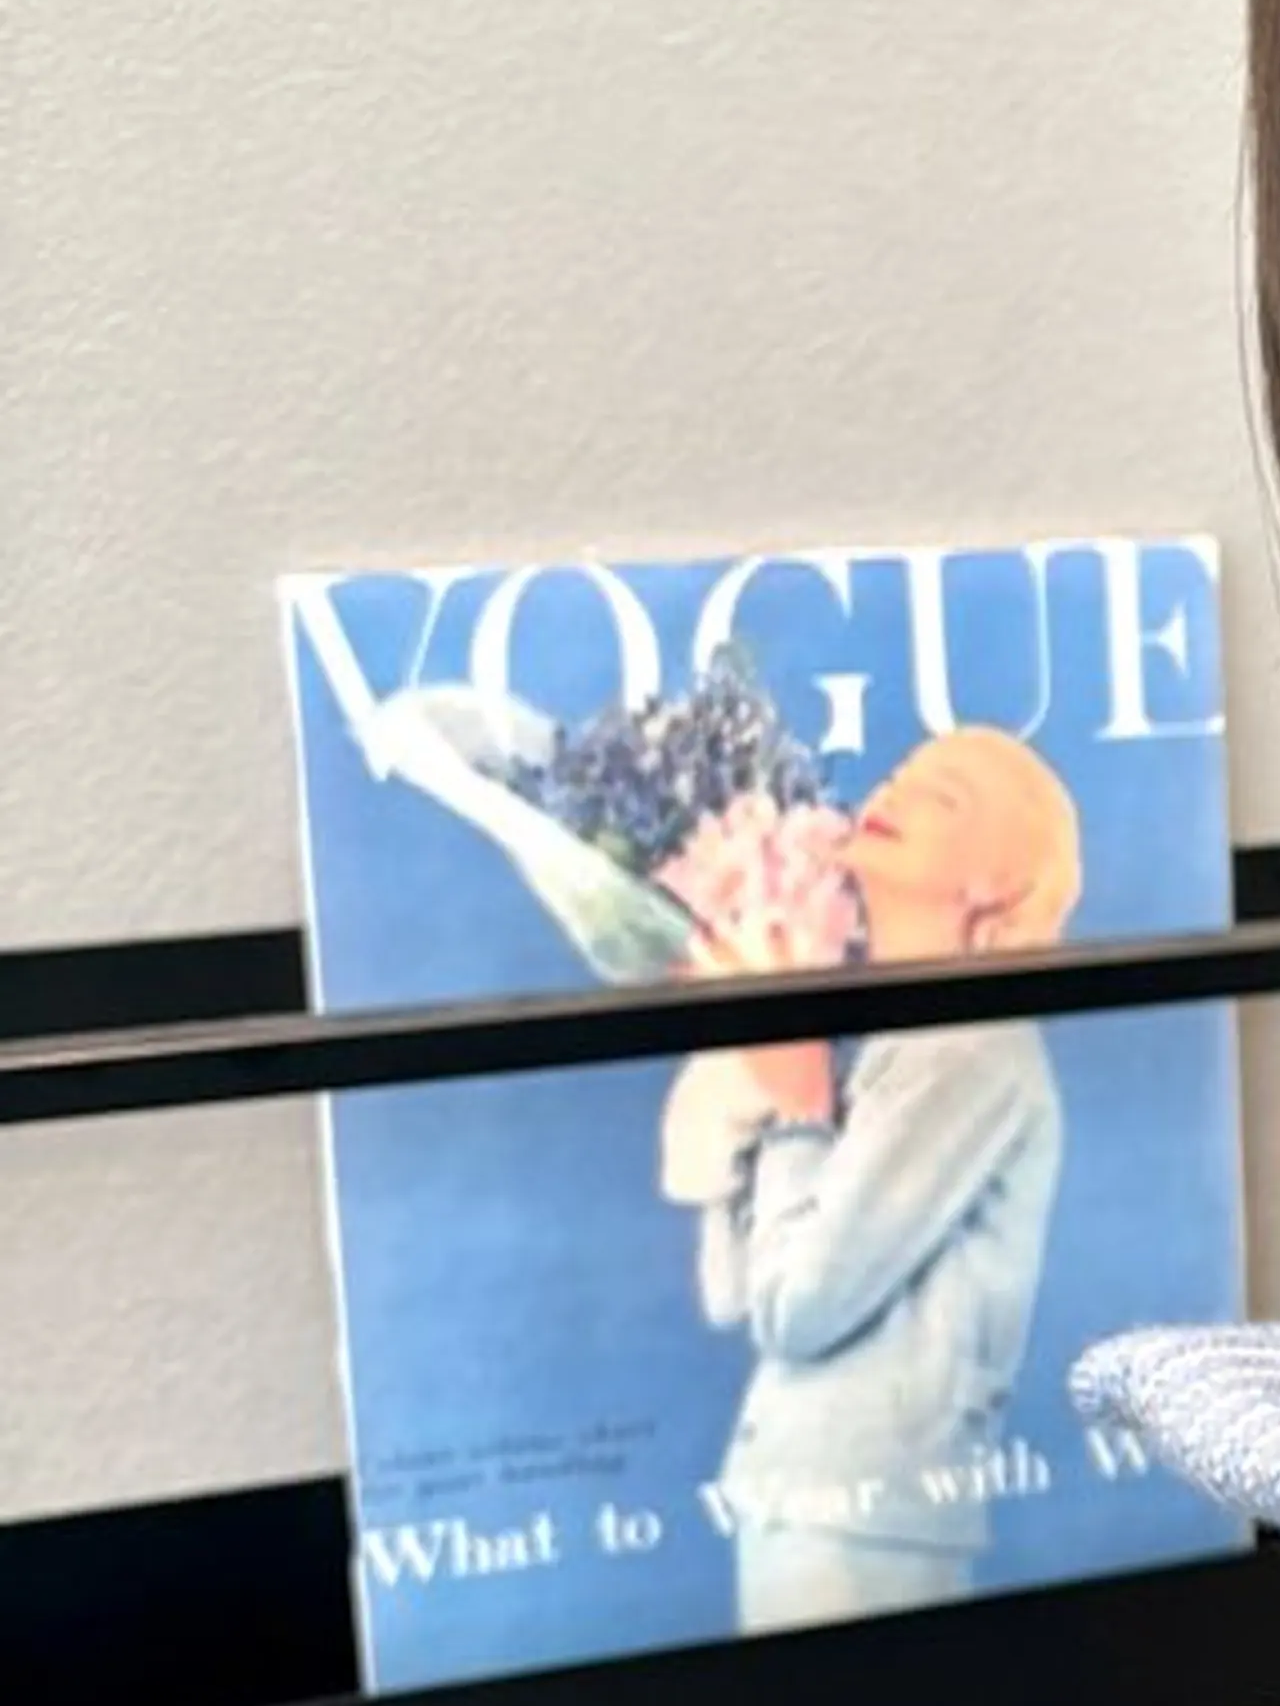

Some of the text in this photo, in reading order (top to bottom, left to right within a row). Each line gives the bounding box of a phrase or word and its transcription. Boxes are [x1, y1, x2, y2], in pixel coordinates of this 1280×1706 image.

[290, 534, 1226, 781] VOGUE
[362, 1513, 562, 1588] What
[597, 1500, 662, 1555] to
[921, 1435, 1052, 1505] with
